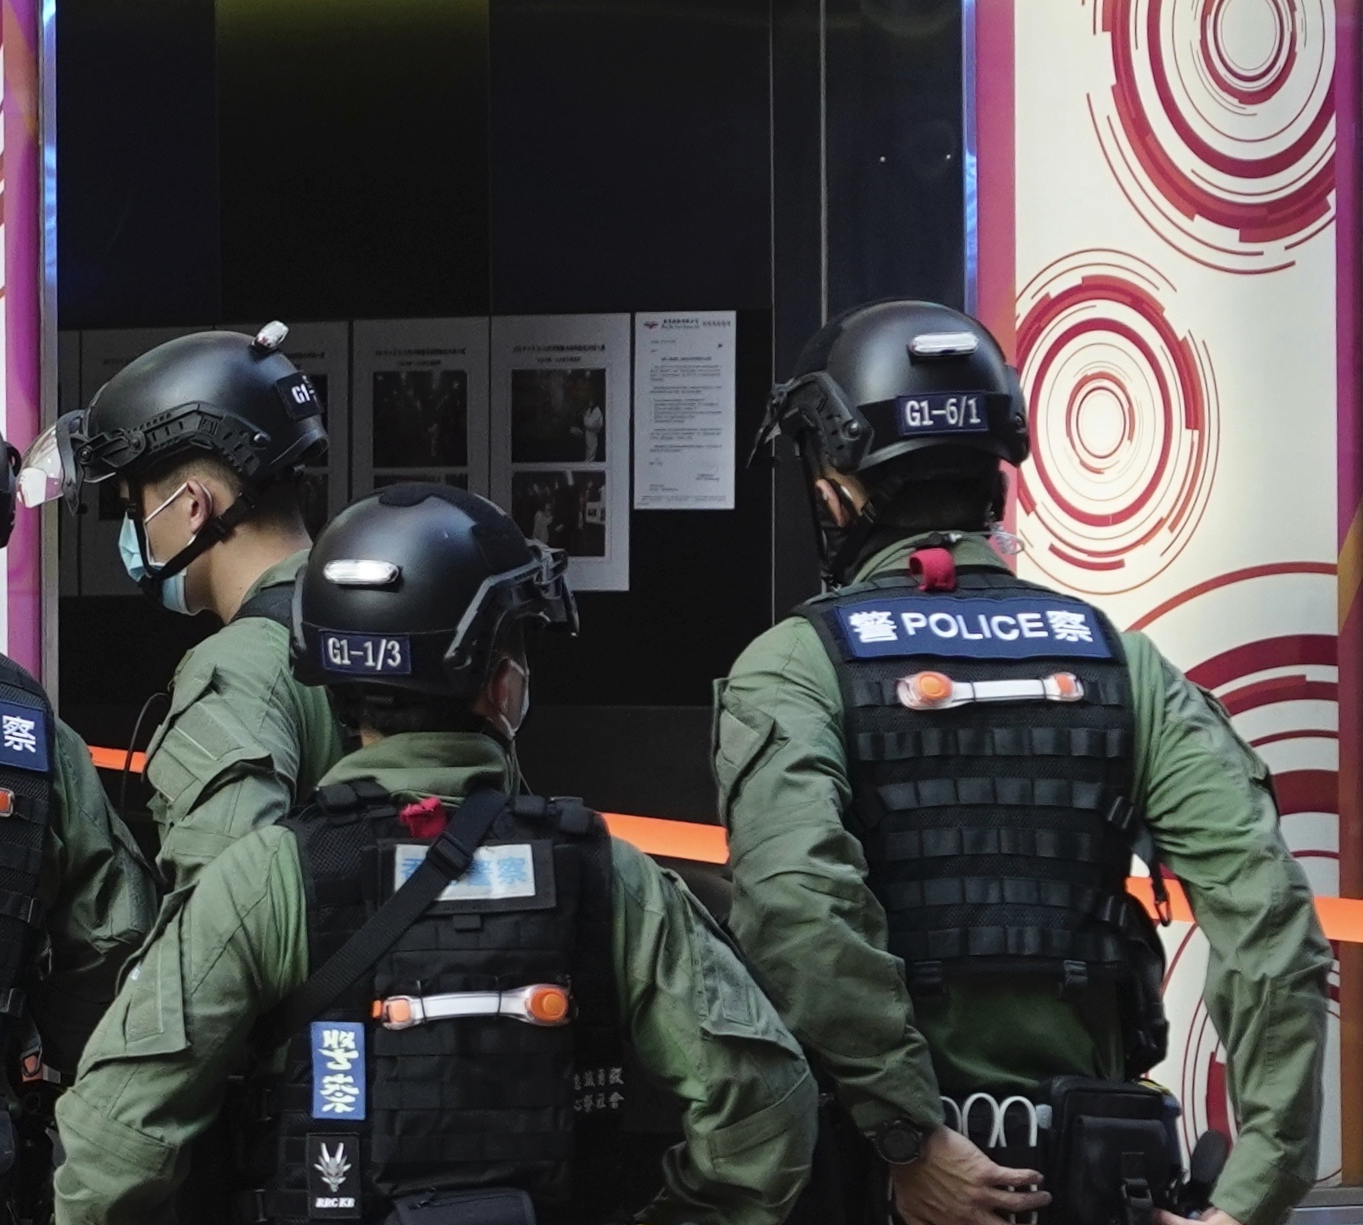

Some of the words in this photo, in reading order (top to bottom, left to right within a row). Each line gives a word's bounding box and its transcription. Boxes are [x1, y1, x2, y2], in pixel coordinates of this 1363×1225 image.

[905, 395, 982, 427] G1-6/1
[850, 611, 899, 643] 警
[902, 611, 1048, 641] POLICE
[1048, 610, 1094, 643] 察
[326, 637, 403, 669] G1-1/3
[2, 714, 37, 754] 察
[318, 1029, 361, 1114] 警察
